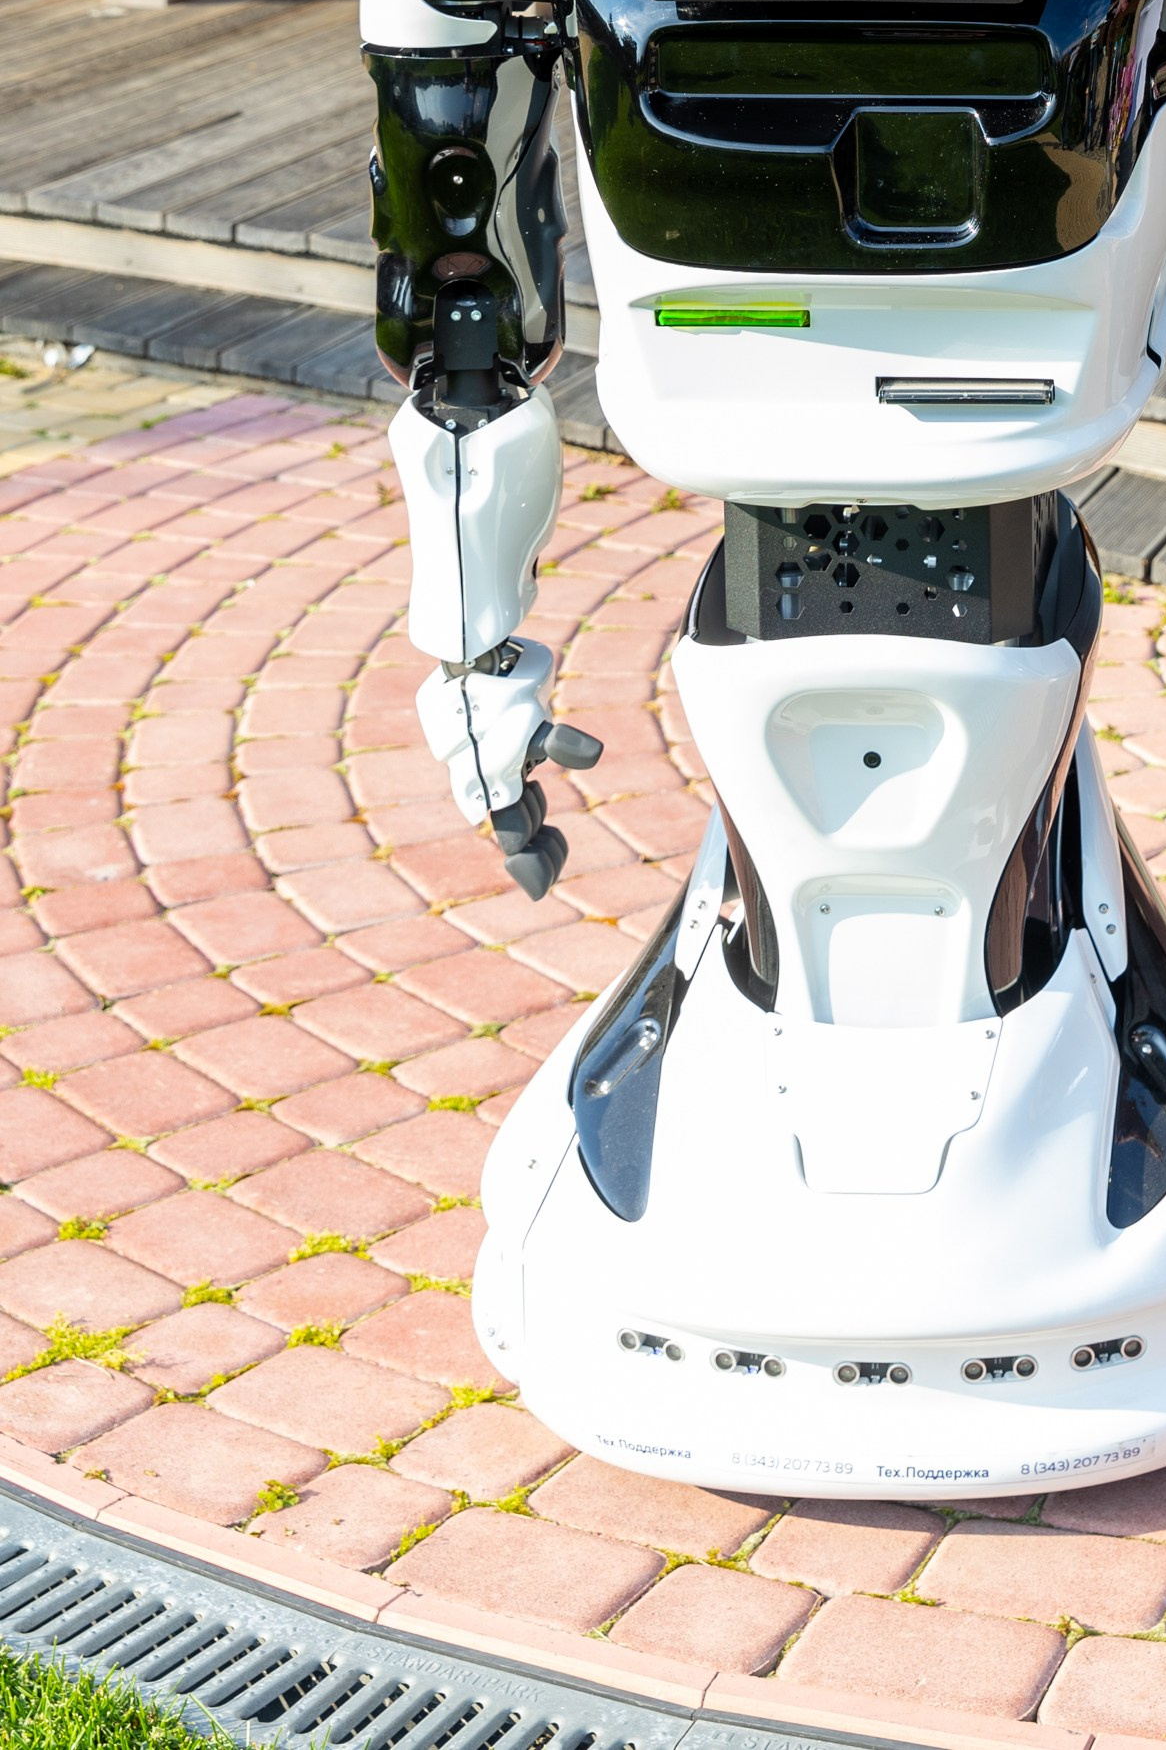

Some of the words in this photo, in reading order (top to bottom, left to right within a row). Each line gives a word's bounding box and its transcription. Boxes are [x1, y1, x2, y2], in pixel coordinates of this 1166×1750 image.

[731, 1452, 741, 1464] 8
[744, 1452, 780, 1469] (343)
[783, 1457, 810, 1472] 207
[815, 1460, 830, 1473] 73
[834, 1462, 854, 1475] 89
[876, 1465, 990, 1480] Тех.Поддержка
[1020, 1464, 1031, 1475] 8
[1034, 1459, 1070, 1475] (343)
[1073, 1456, 1100, 1469] 207
[1104, 1451, 1119, 1463] 73
[1122, 1447, 1141, 1459] 89
[367, 1644, 546, 1702] STANDARTPARK
